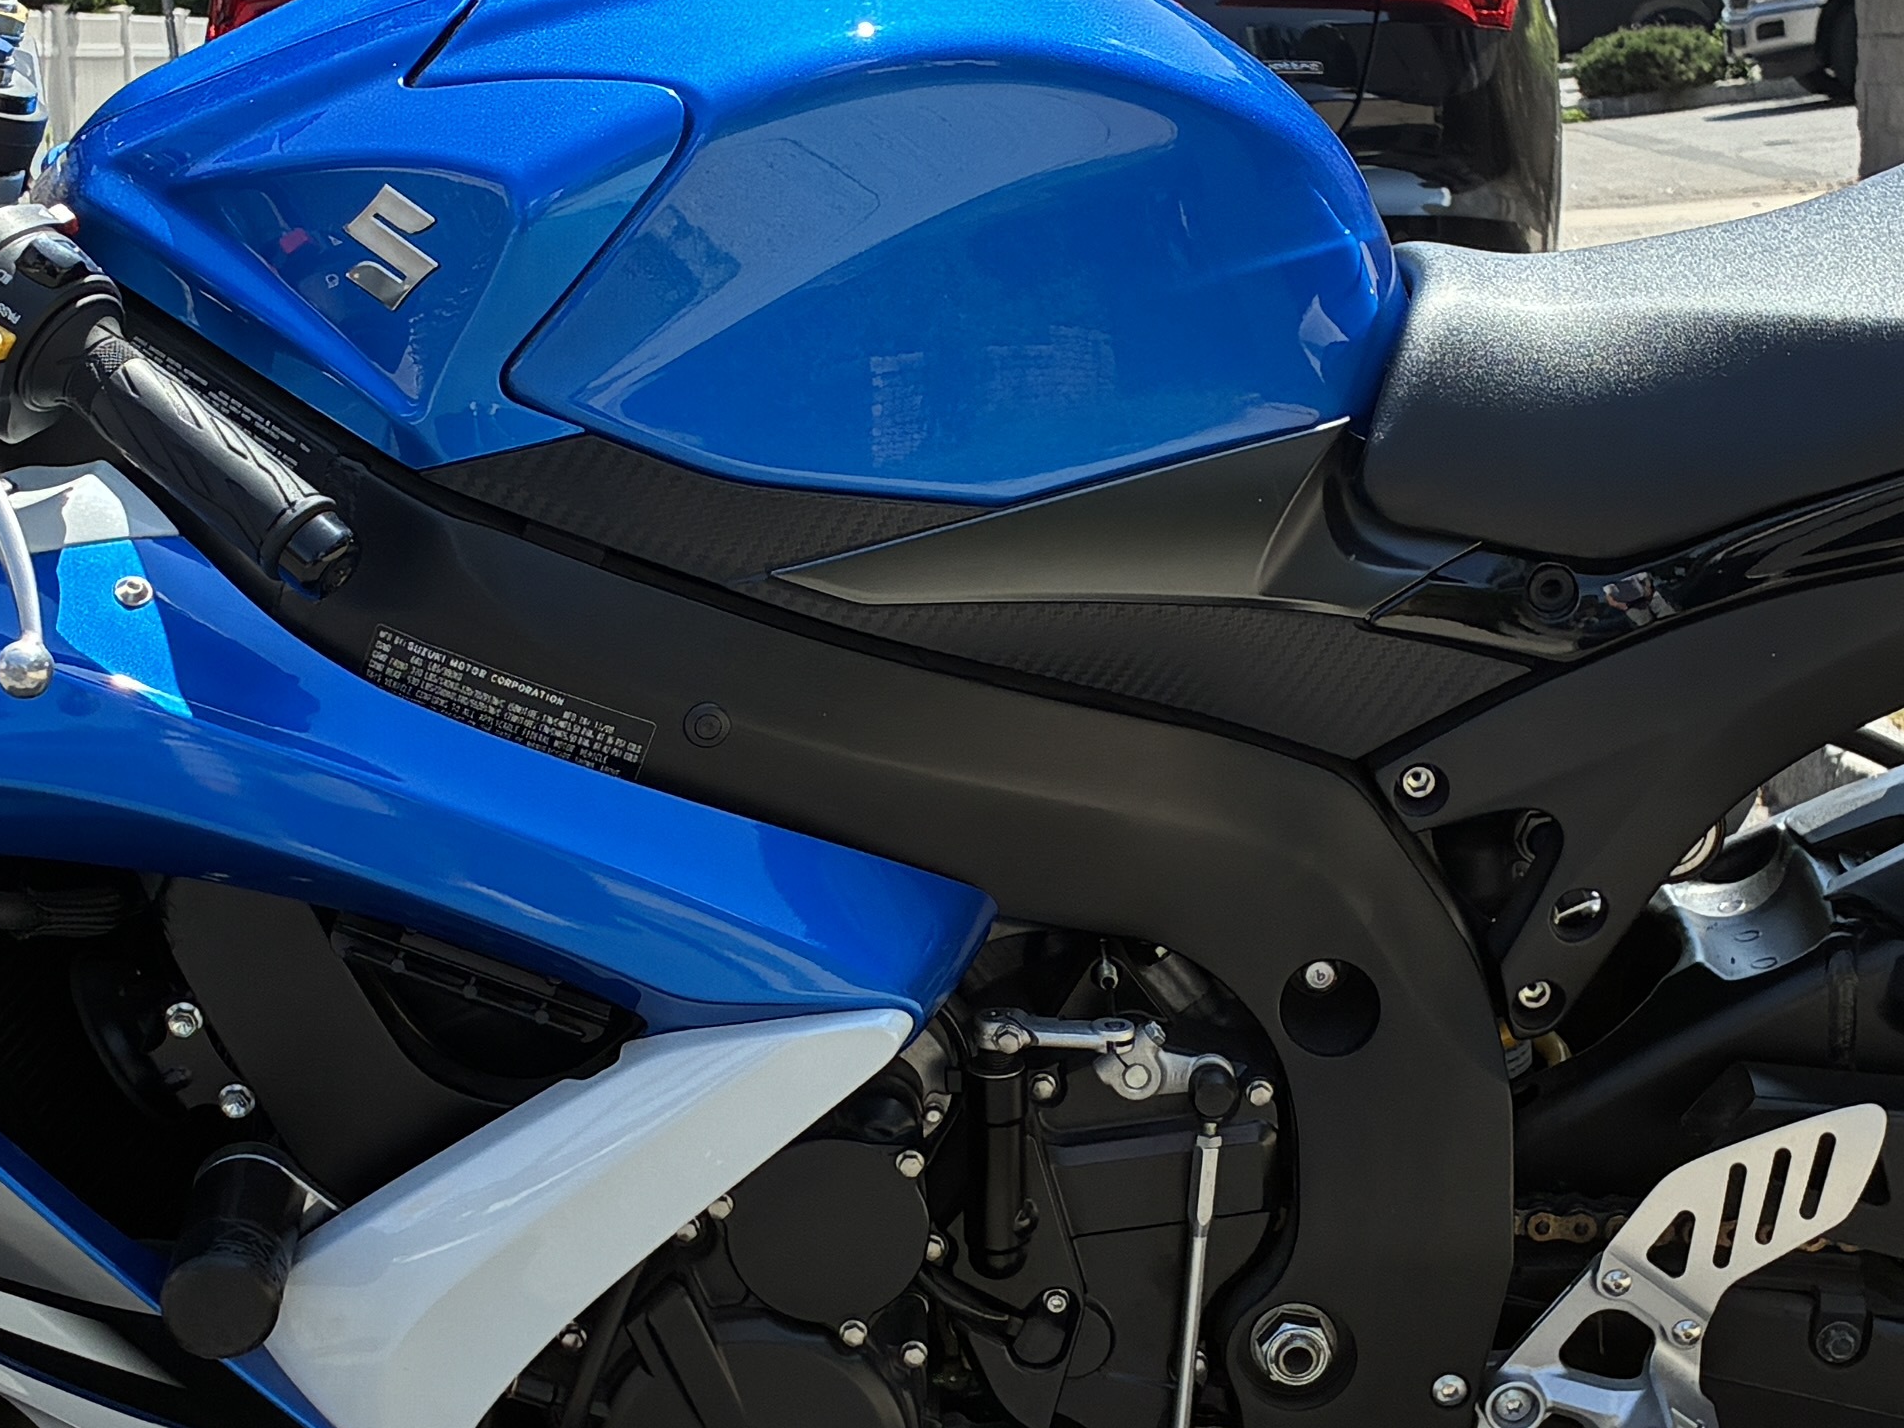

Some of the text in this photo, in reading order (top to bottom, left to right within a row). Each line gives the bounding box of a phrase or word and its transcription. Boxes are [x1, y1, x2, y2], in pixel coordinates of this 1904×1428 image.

[407, 642, 446, 663] SUZUKI
[450, 658, 487, 678] MOTOR
[490, 674, 566, 706] CORPORATION
